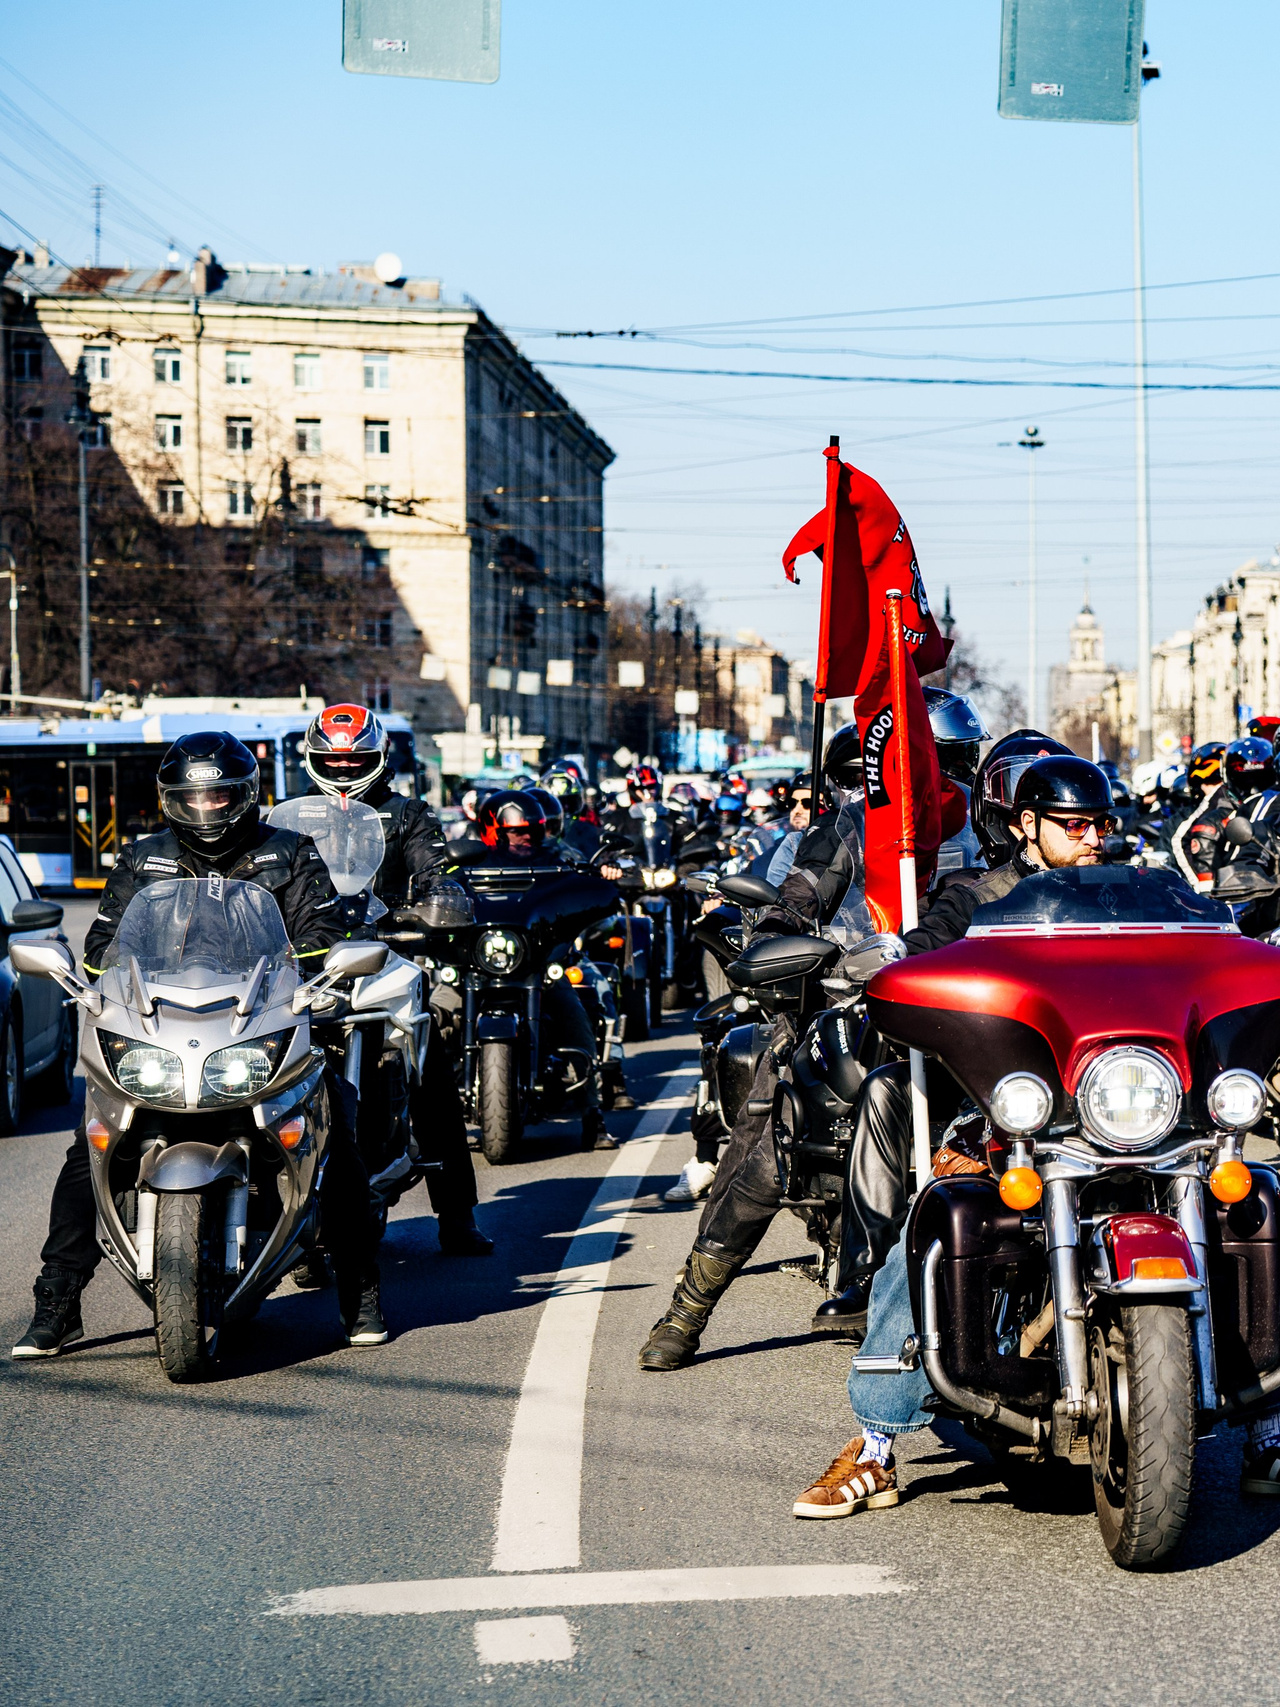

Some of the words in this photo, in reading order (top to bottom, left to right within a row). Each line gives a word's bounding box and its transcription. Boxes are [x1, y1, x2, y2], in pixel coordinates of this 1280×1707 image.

[866, 709, 894, 753] HOO
[190, 768, 218, 780] SHOEI
[865, 754, 882, 795] THE
